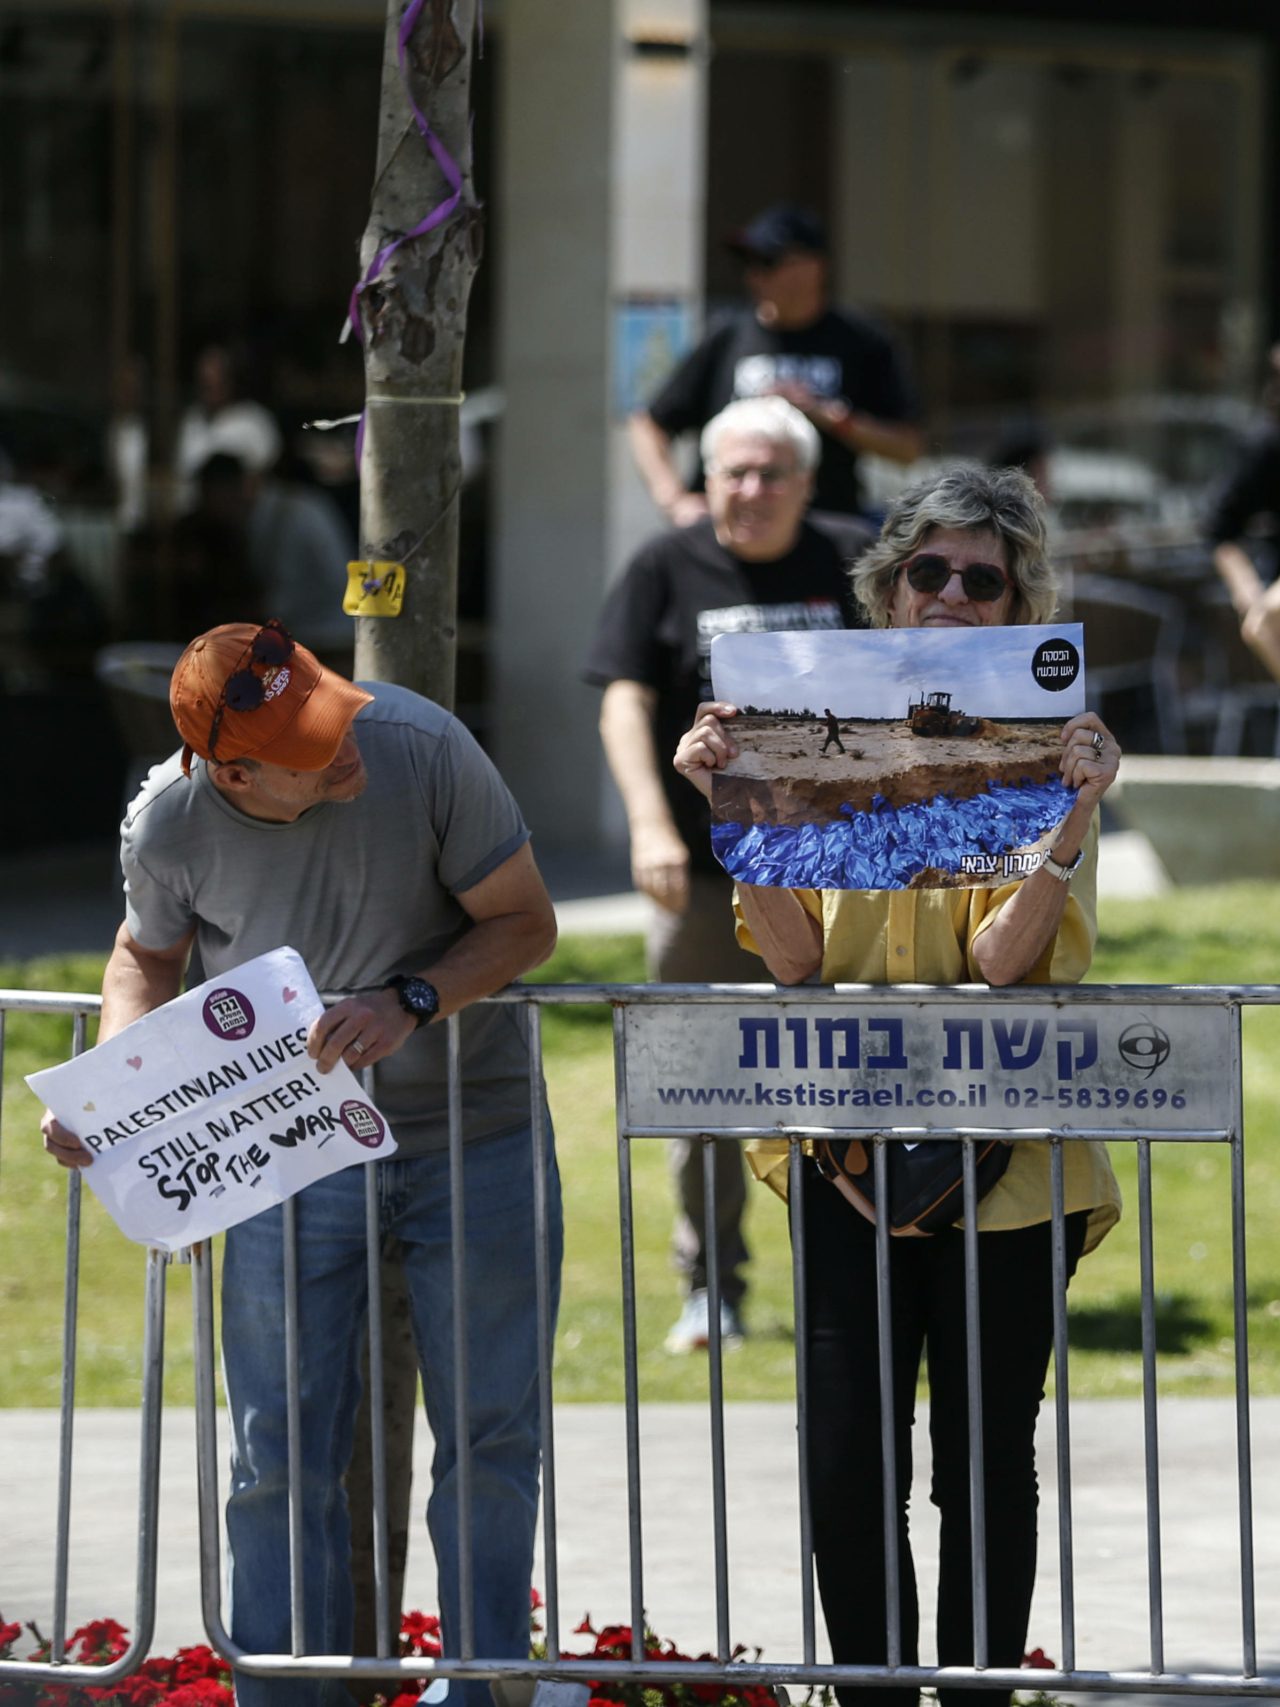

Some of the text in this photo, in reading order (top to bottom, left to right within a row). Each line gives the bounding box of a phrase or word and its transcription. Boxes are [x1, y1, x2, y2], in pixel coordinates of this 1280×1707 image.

[1042, 650, 1069, 662] הפסקת
[1036, 665, 1074, 677] אש עכשיו
[960, 854, 999, 874] צבאי
[1002, 852, 1041, 878] פתרון
[212, 998, 239, 1015] נגד
[246, 1026, 308, 1074] LIVES
[737, 1016, 1100, 1081] קשת במות
[658, 1081, 1188, 1111] www.kstisrael.co.il 02-5839696
[347, 1110, 370, 1123] נגד
[138, 1129, 210, 1179] STILL
[158, 1105, 343, 1212] STOP THE WAR
